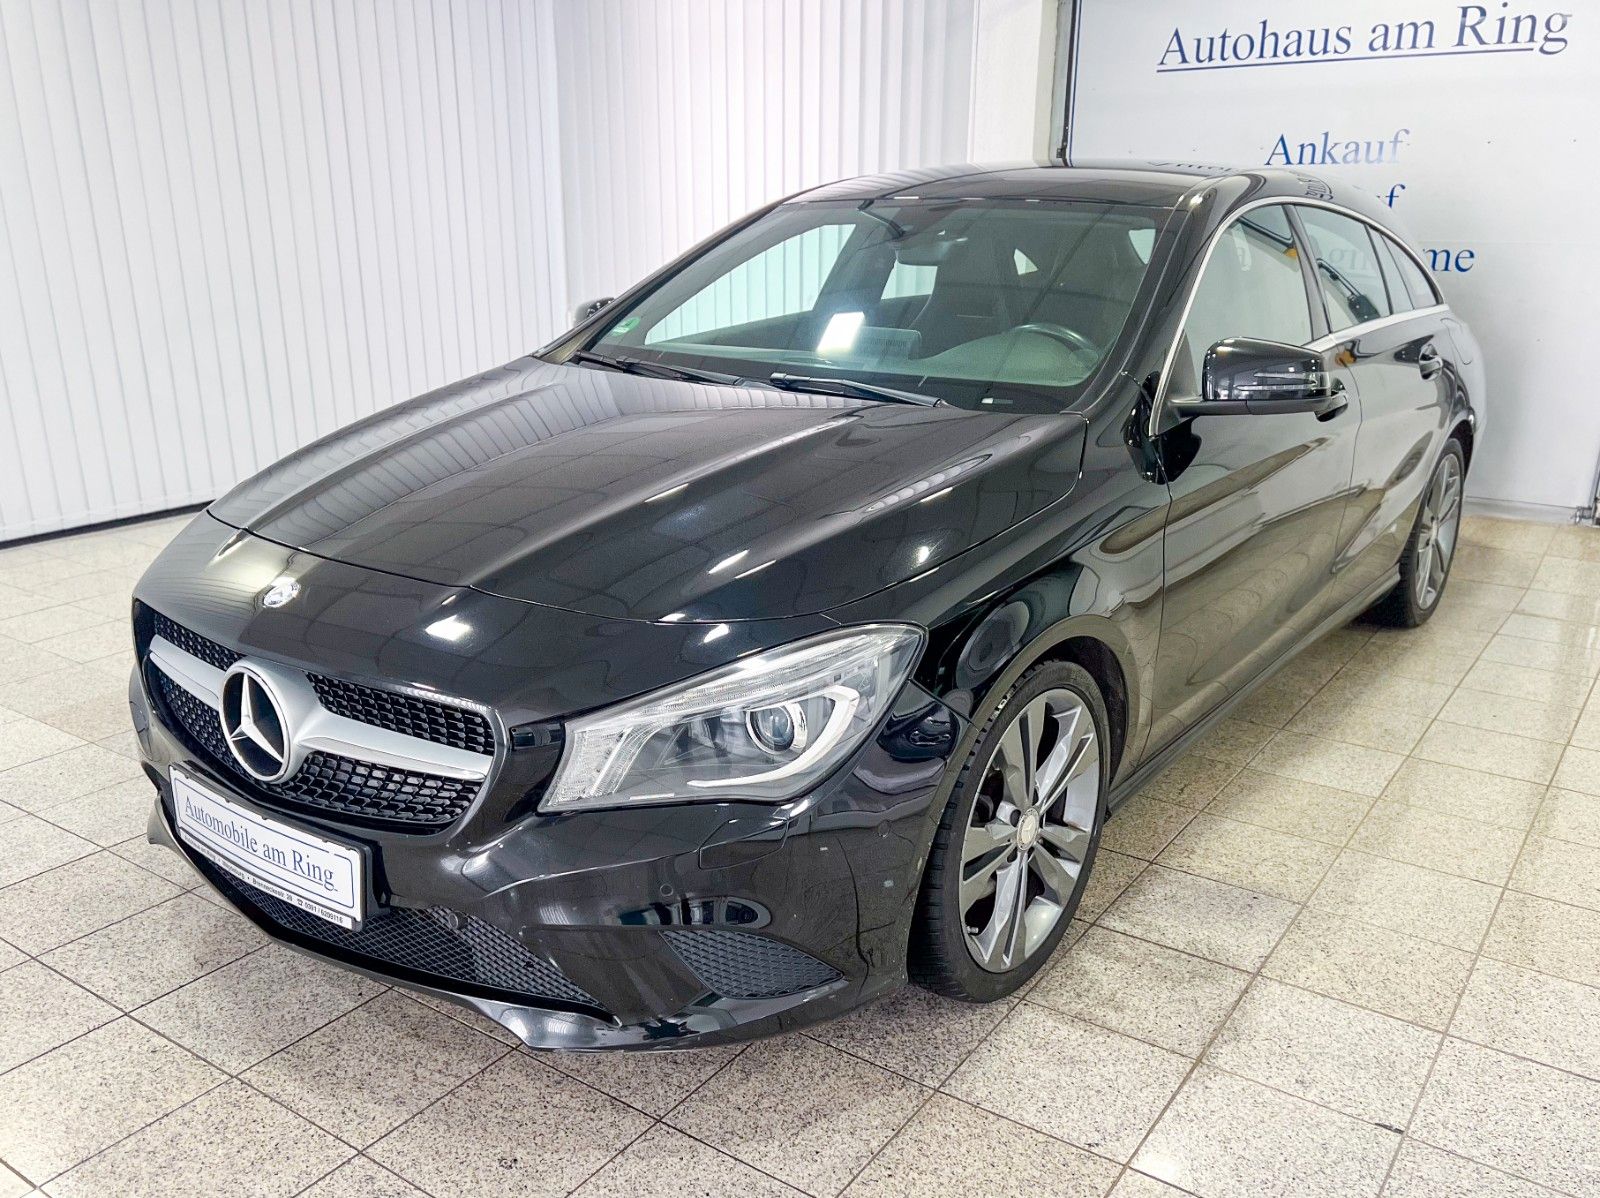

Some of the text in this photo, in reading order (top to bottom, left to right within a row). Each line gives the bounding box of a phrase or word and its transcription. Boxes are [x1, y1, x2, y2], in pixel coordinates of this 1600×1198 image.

[1159, 2, 1573, 67] Autohaus am Ring
[1264, 128, 1411, 167] Ankauf
[184, 795, 258, 854] Automobile
[262, 841, 287, 867] am
[290, 849, 335, 892] Ring
